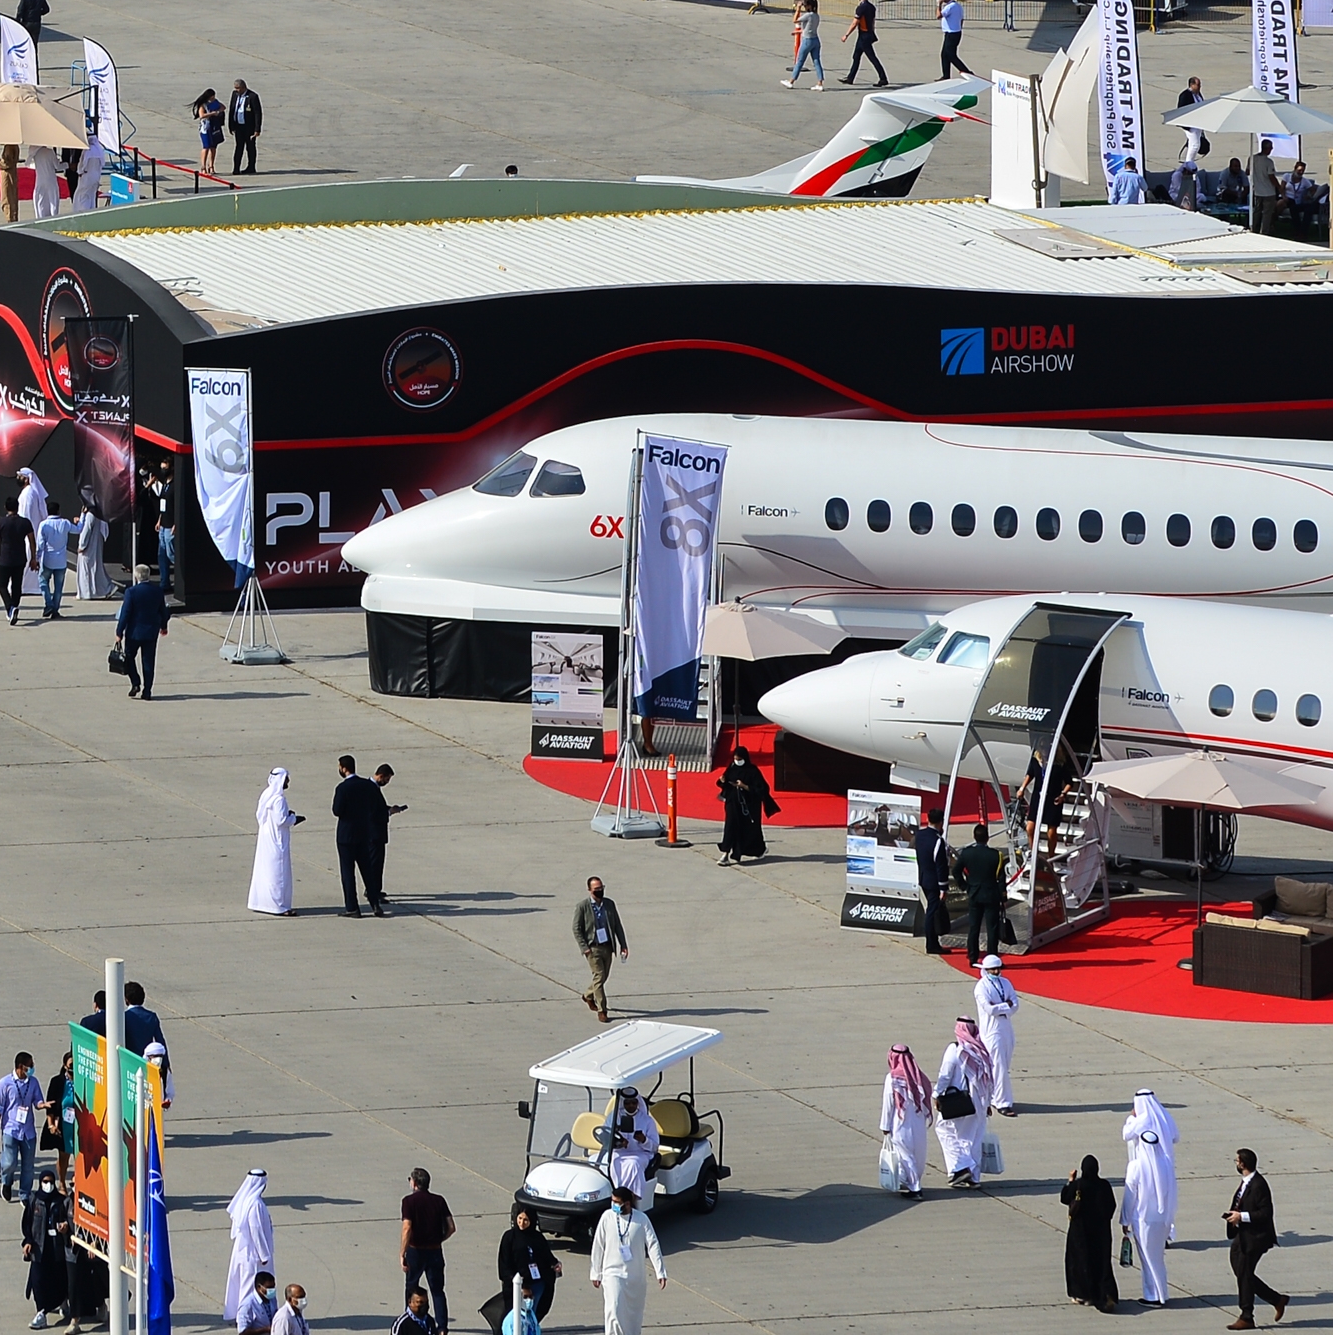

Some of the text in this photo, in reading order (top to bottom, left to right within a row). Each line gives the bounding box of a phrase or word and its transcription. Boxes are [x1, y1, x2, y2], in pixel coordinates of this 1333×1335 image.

[991, 325, 1075, 351] DUBAI
[990, 354, 1075, 374] AIRSHOW
[191, 377, 241, 398] Falcon
[205, 401, 248, 475] 6X
[648, 444, 721, 474] Falcon
[659, 474, 717, 556] 8X
[748, 505, 789, 517] Falcon
[589, 515, 624, 539] 6X
[264, 561, 329, 575] YOUTH
[659, 696, 693, 707] DASSAULT
[1128, 687, 1170, 704] Falcon
[658, 701, 690, 711] AVIATION
[1000, 703, 1051, 716] DASSAULT
[999, 710, 1046, 722] AVIATION
[549, 734, 596, 745] DASSAULT
[549, 741, 591, 751] AVIATION
[860, 911, 903, 923] AVIATION
[862, 903, 909, 917] DASSAULT
